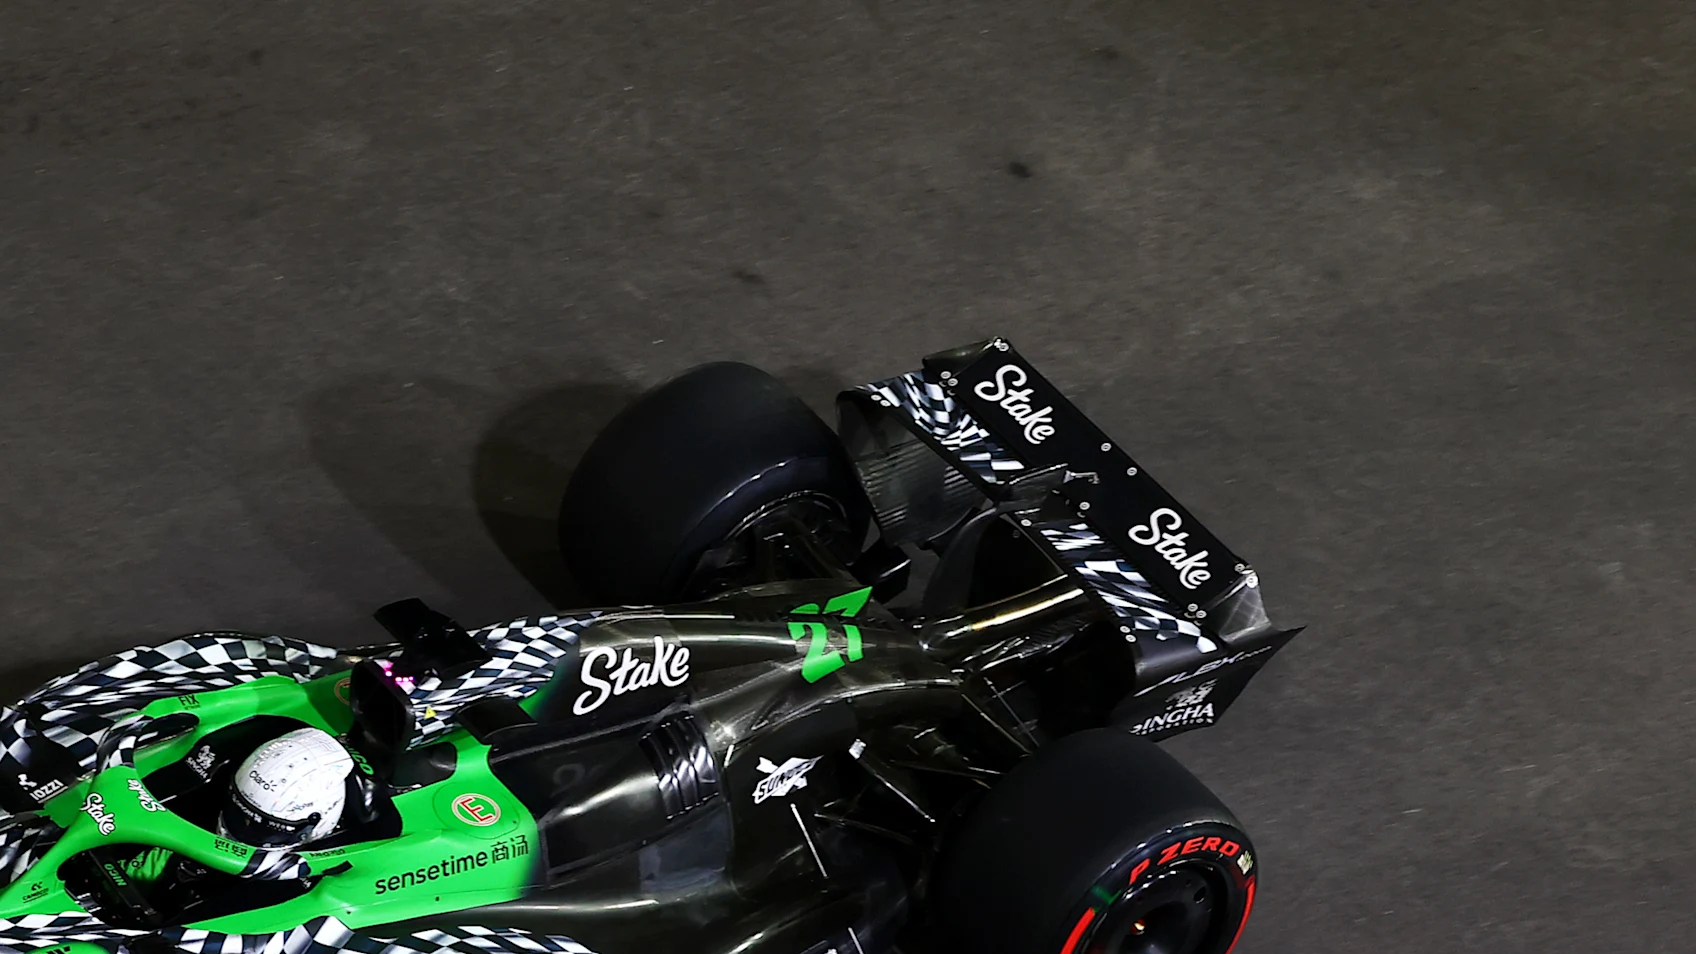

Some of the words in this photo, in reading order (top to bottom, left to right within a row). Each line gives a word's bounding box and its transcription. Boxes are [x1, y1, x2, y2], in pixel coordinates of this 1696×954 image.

[974, 364, 1055, 444] Stake
[1128, 507, 1212, 590] Stake
[572, 636, 691, 716] Stake
[29, 779, 64, 800] OZZI
[249, 770, 270, 790] Claro
[80, 792, 115, 836] Stake
[104, 863, 127, 886] NICO
[375, 851, 488, 895] sensetime
[490, 834, 529, 864] 商汤
[1129, 858, 1151, 885] P
[1157, 836, 1240, 865] ZERO
